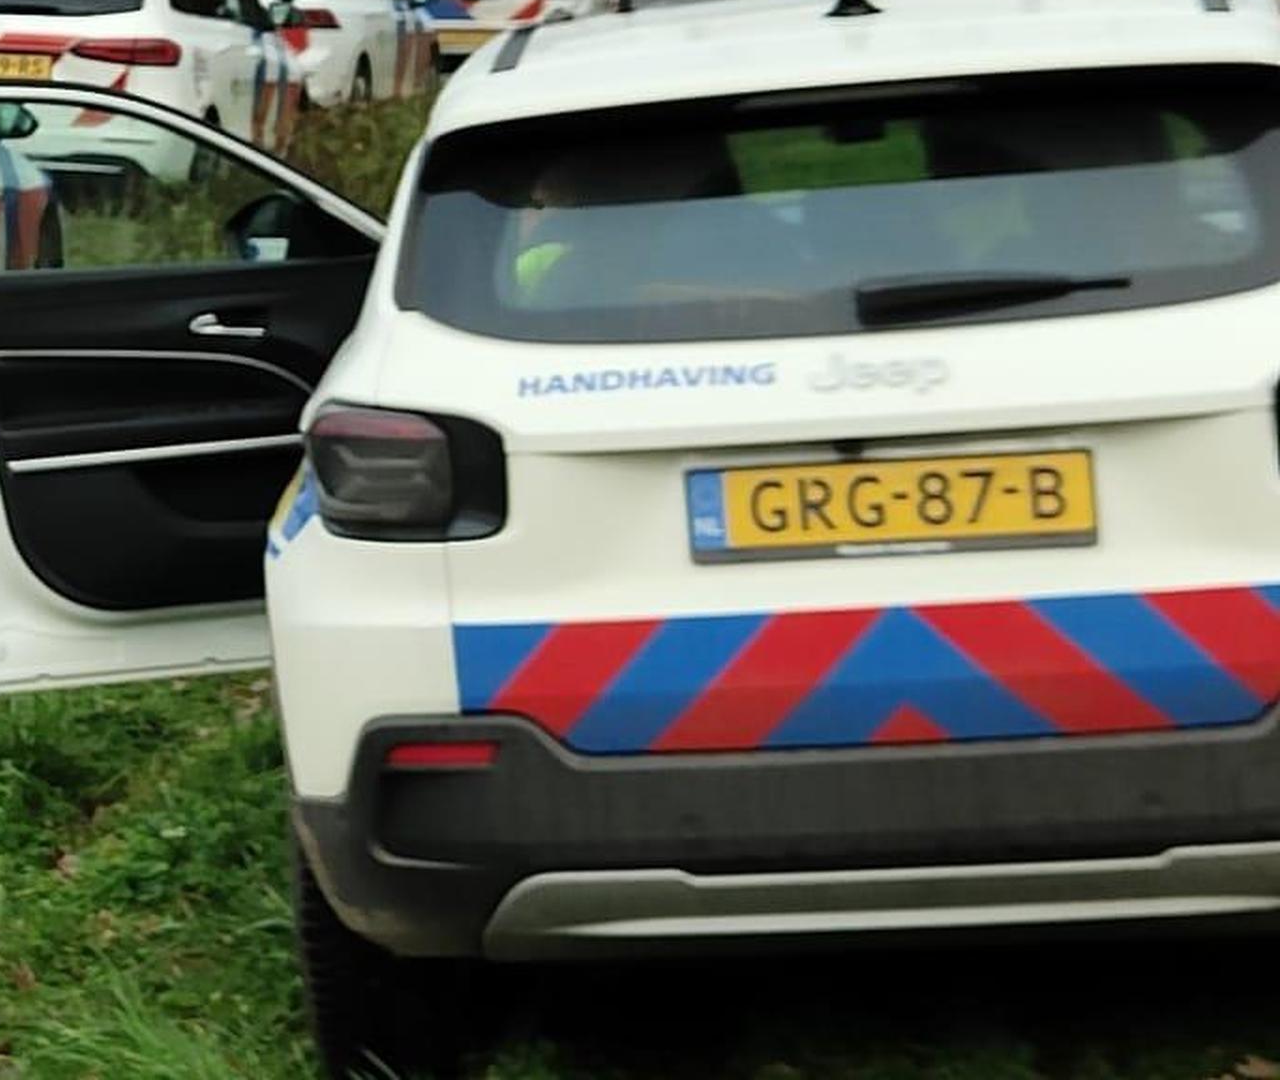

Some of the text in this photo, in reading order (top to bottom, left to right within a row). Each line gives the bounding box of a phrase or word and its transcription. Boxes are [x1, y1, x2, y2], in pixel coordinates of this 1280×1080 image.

[517, 362, 778, 398] HANDHAVING
[808, 351, 950, 395] Jeep
[750, 465, 1068, 533] GRG-87-B
